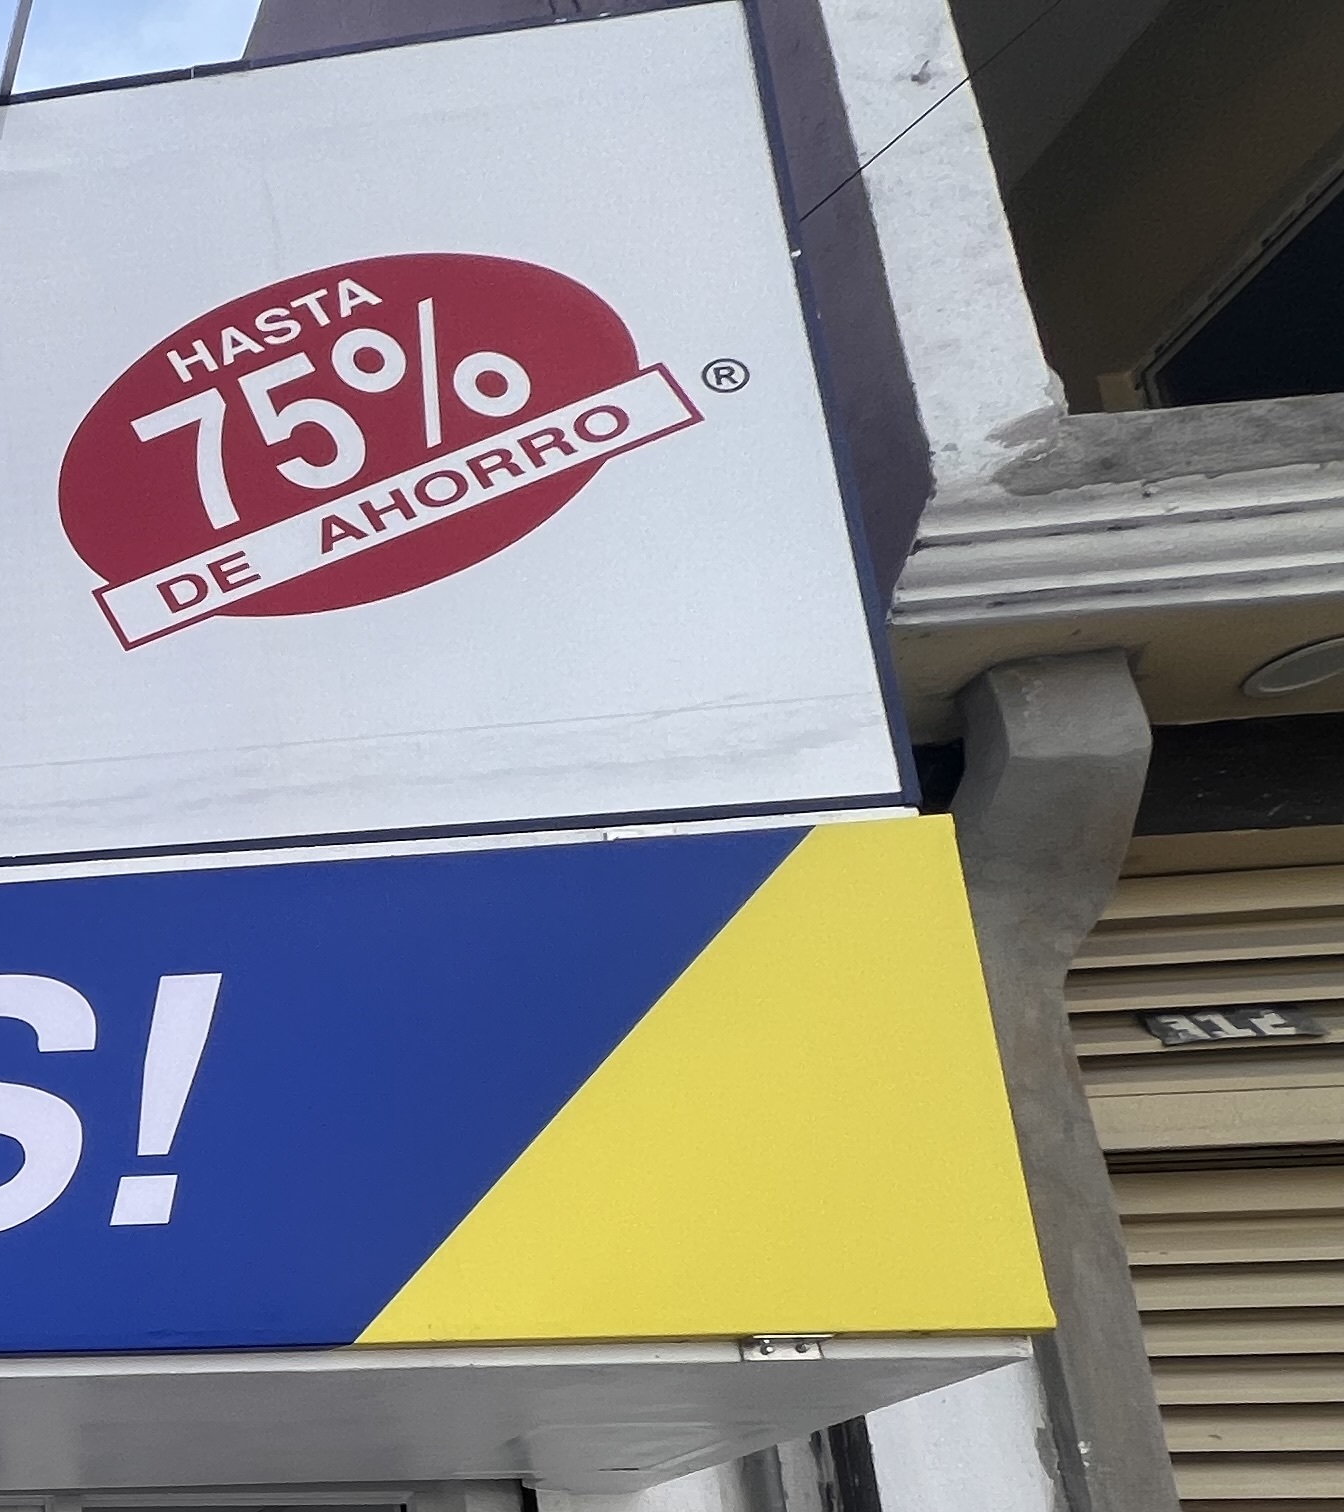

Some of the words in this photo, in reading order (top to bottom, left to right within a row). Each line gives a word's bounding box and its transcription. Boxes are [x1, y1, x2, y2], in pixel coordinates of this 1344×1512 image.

[131, 297, 532, 530] 75%
[167, 278, 382, 384] HASTA
[157, 551, 262, 614] DE
[318, 404, 631, 555] AHORRO
